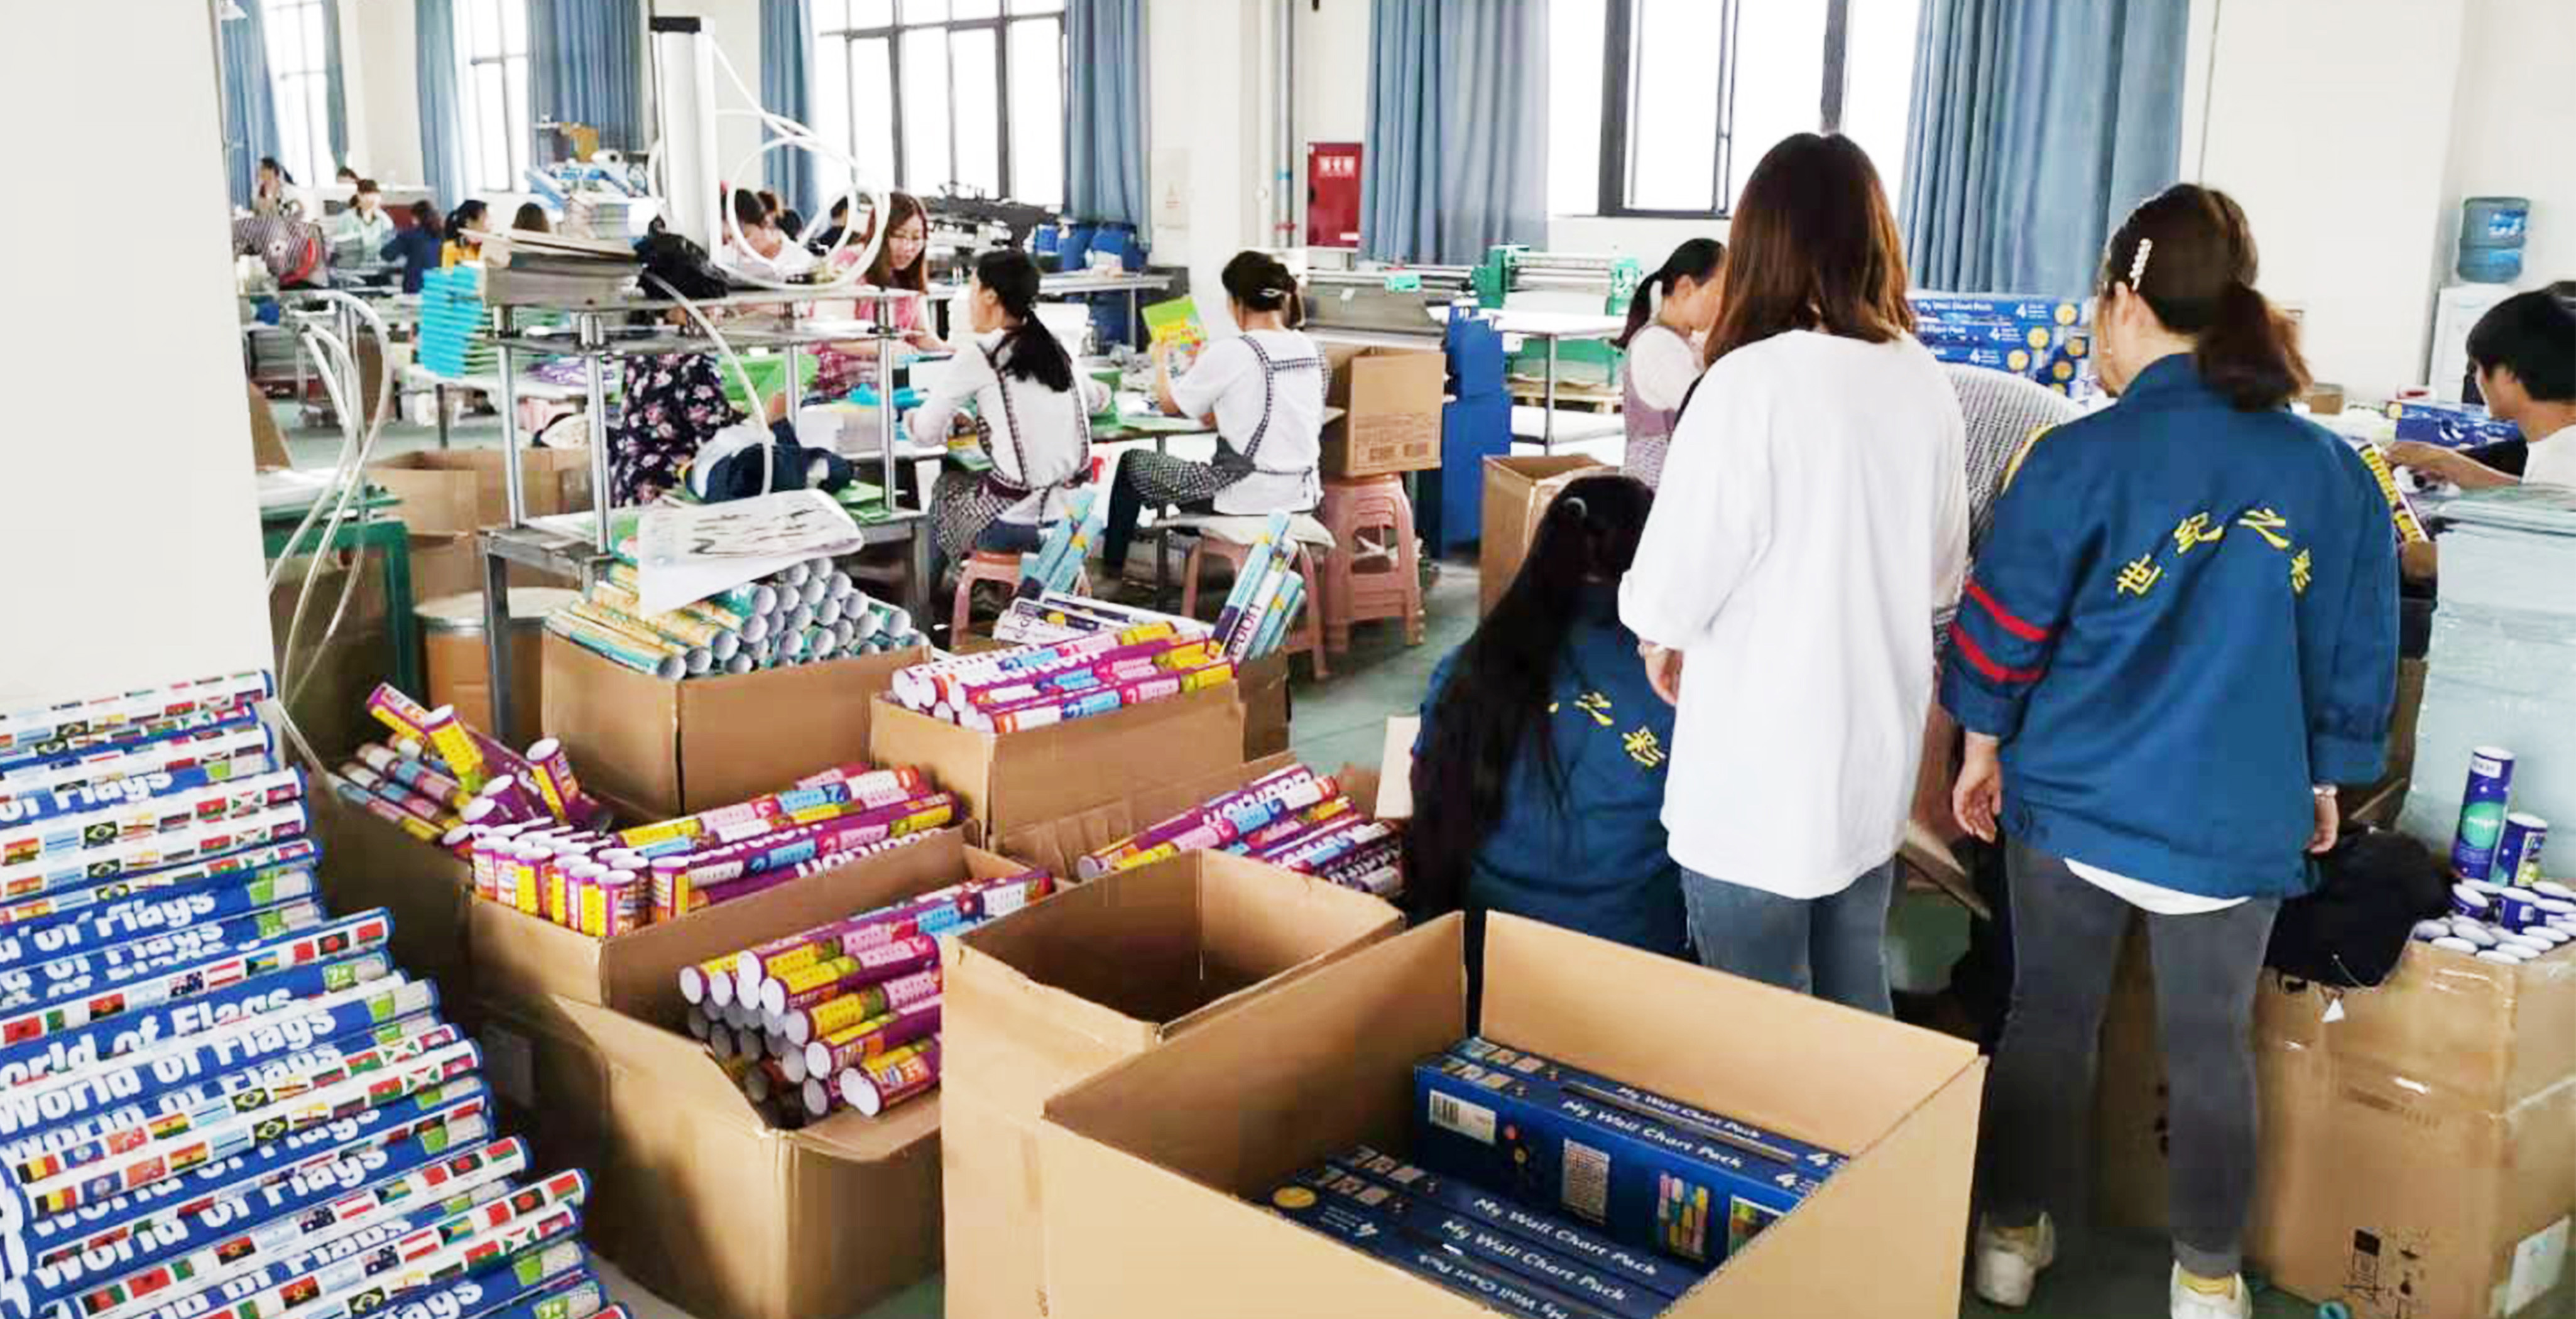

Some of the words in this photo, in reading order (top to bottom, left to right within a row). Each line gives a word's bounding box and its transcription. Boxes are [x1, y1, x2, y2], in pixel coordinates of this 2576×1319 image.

[2016, 303, 2026, 318] 4
[1989, 327, 2000, 340] 4
[1970, 349, 1980, 364] 4
[212, 1007, 337, 1067] Flags
[0, 1034, 100, 1088] orld
[1680, 1107, 1722, 1126] Chart
[1562, 1100, 1590, 1118] My
[1596, 1111, 1639, 1131] Wall
[1642, 1127, 1693, 1151] Chart
[1698, 1146, 1743, 1169] Pack
[1806, 1153, 1829, 1167] 4
[1775, 1173, 1798, 1188] 4
[1473, 1198, 1502, 1217] My
[1509, 1211, 1553, 1235] Wall
[1556, 1229, 1608, 1256] Chart
[1611, 1251, 1657, 1276] Pack
[1442, 1220, 1471, 1240] My
[1476, 1233, 1520, 1257] Wall
[1522, 1252, 1577, 1281] Chart
[1578, 1274, 1627, 1301] Pack
